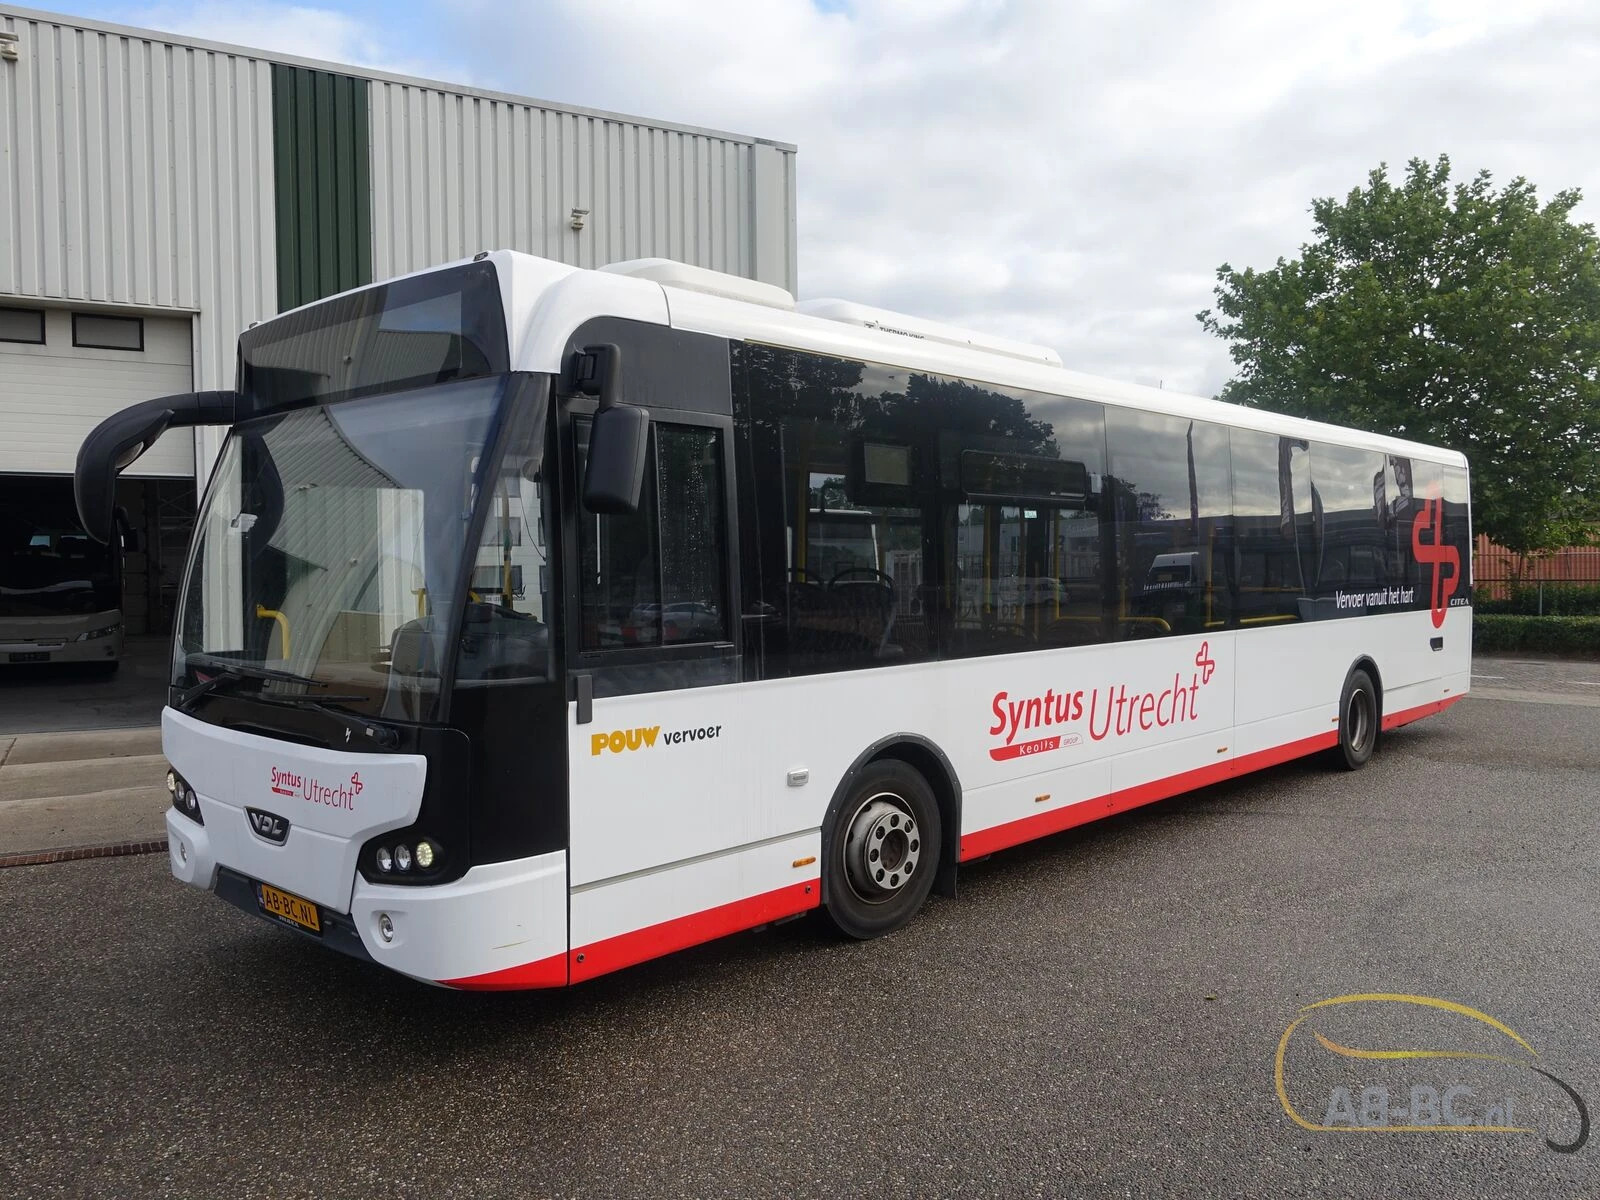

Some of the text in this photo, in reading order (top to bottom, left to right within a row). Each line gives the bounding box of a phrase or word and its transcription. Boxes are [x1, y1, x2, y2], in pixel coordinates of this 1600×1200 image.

[1336, 585, 1414, 608] Vervoer vanuit het hart
[989, 673, 1199, 746] Syntus Utrecht
[591, 725, 722, 756] POUW vervoer
[1019, 740, 1054, 756] Keolis
[271, 766, 354, 811] Syntus Utrecht
[250, 812, 283, 835] VDL
